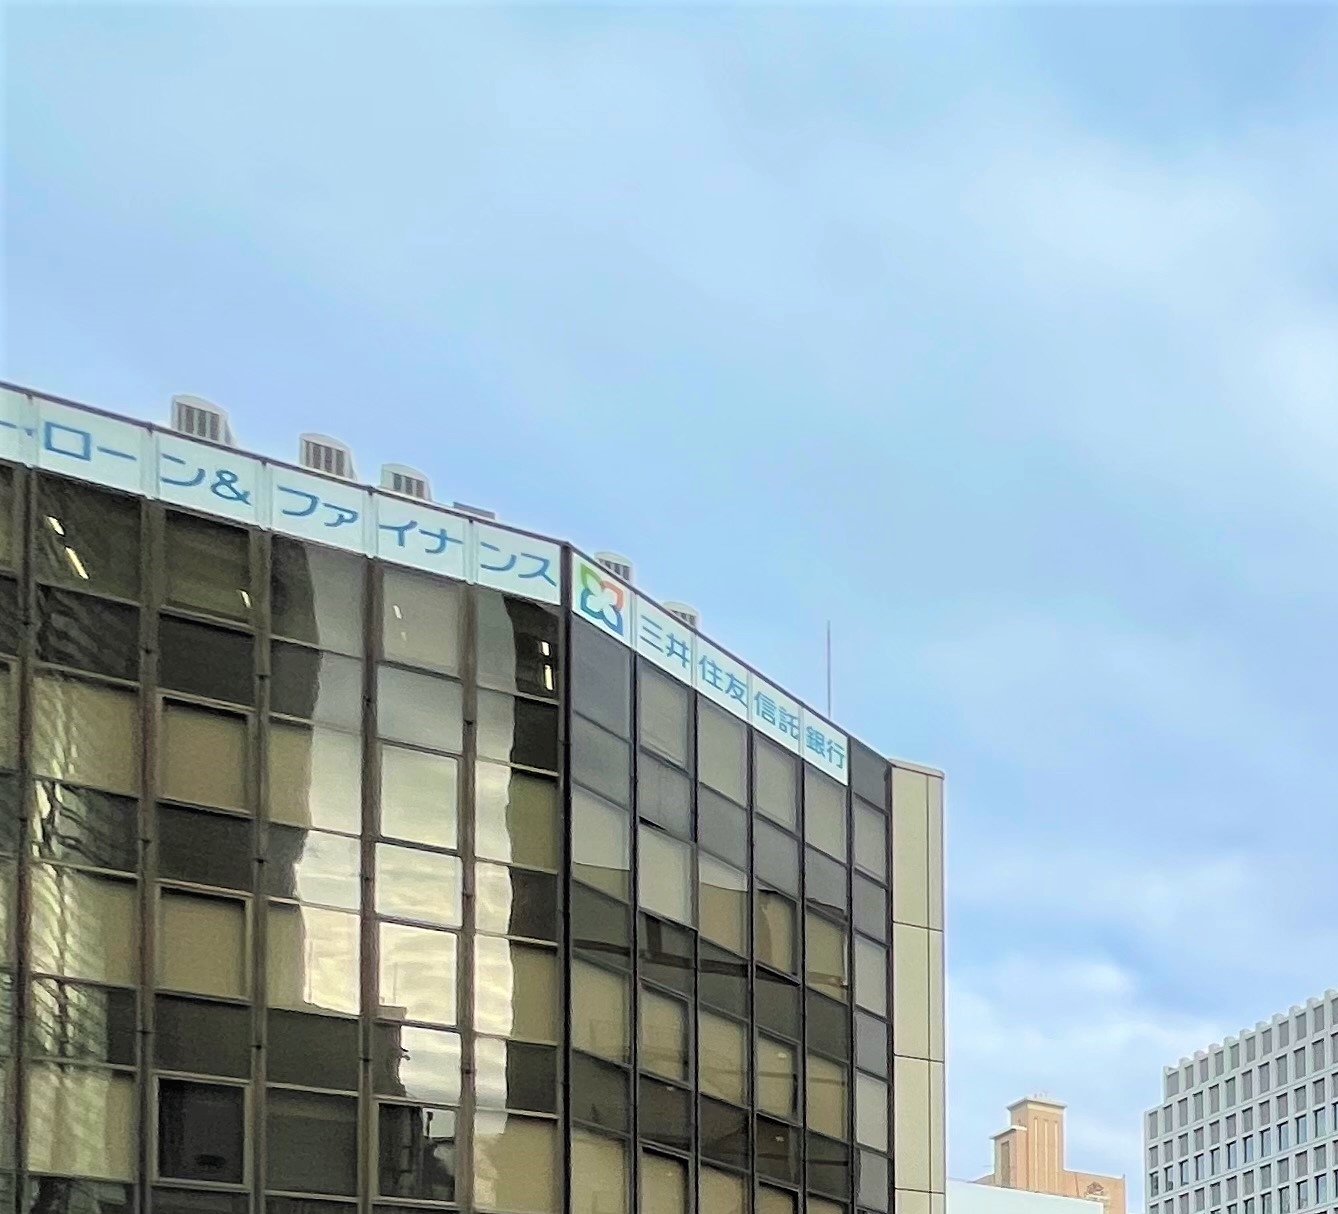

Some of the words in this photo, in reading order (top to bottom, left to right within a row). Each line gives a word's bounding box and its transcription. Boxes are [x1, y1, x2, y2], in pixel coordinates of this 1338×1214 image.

[638, 618, 846, 770] 三井住友信託銀行
